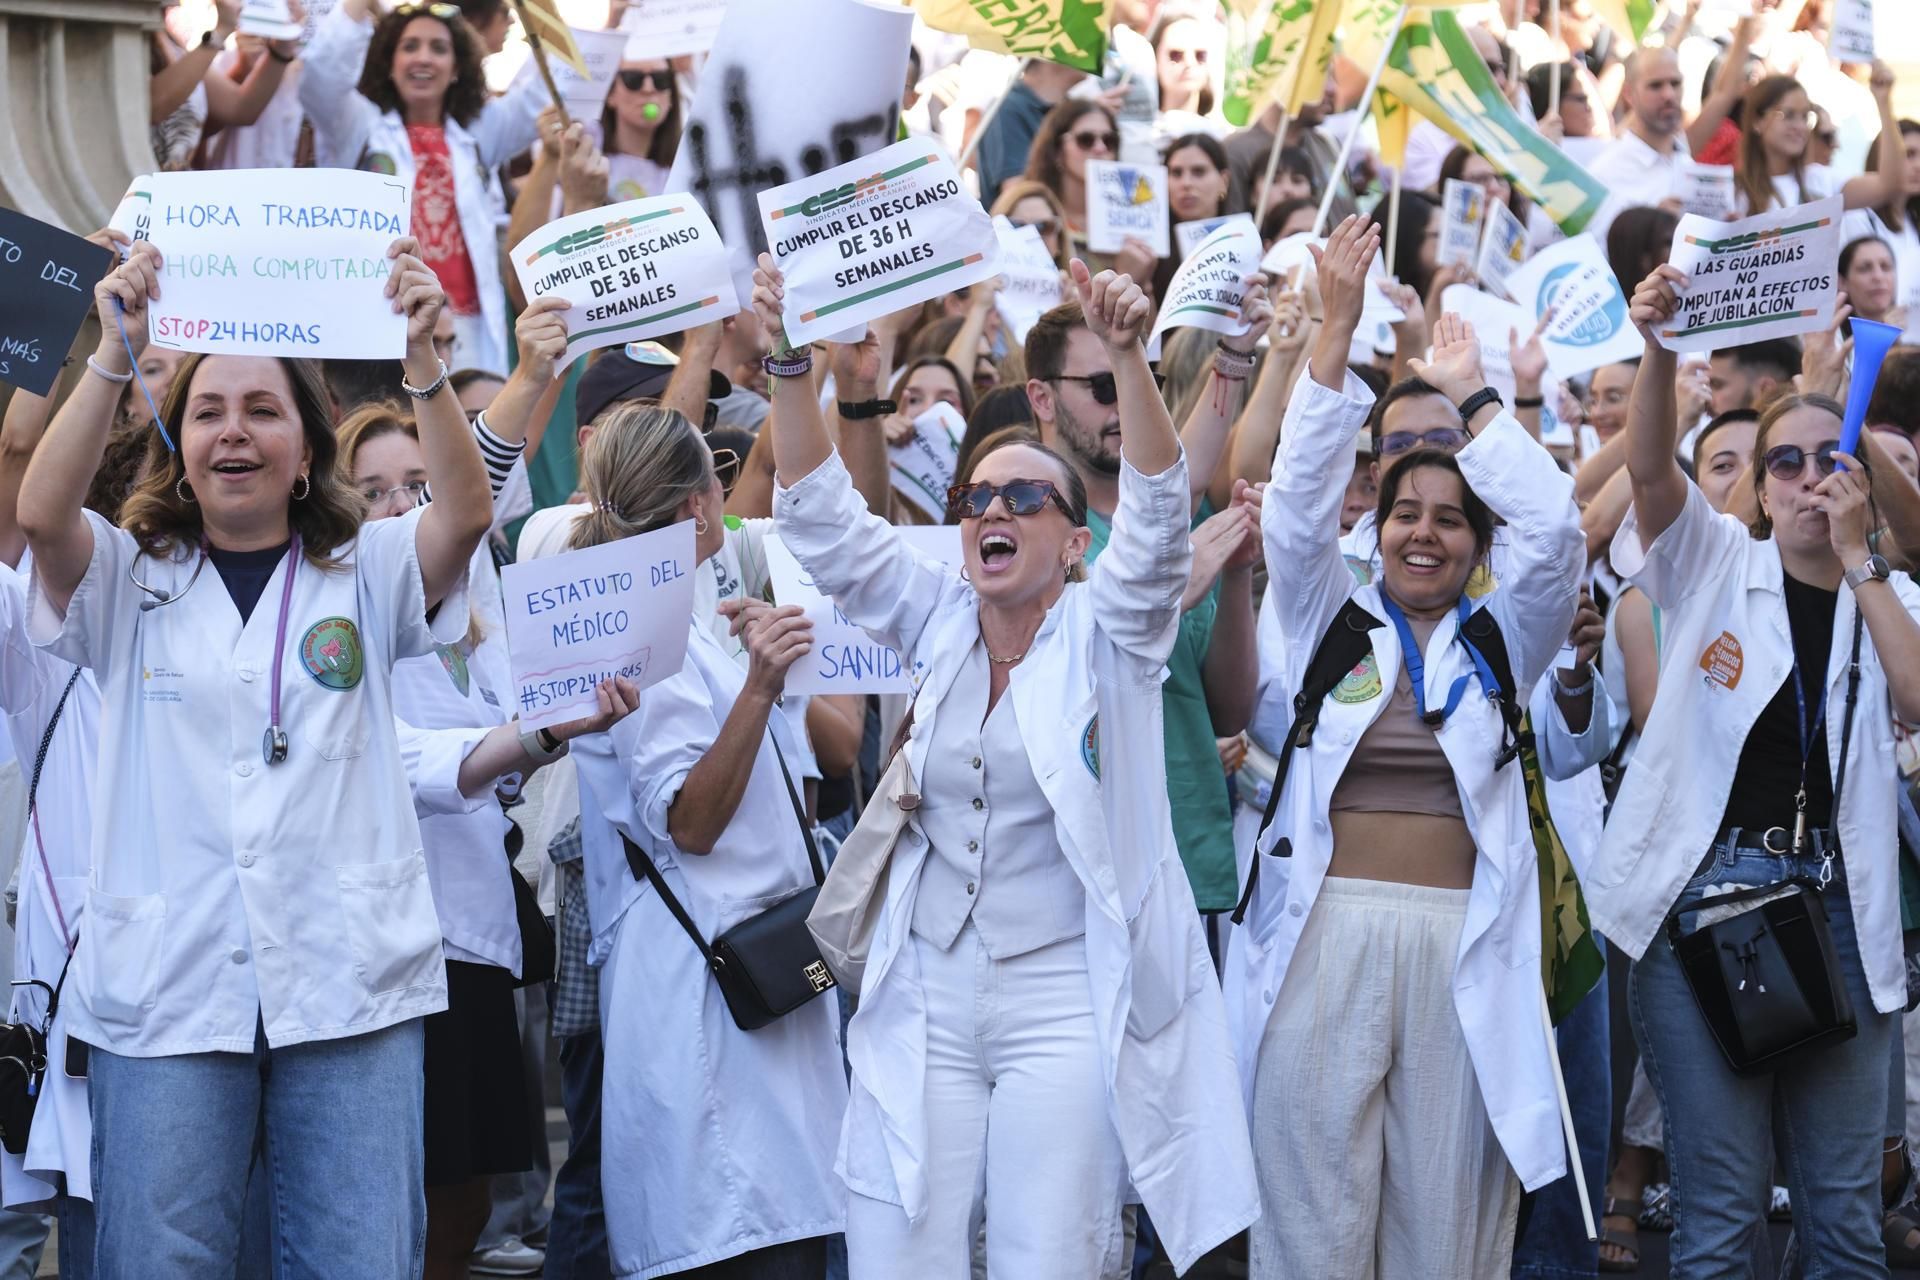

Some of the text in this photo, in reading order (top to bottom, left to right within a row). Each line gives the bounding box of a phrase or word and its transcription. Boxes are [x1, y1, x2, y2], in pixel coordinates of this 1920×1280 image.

[166, 203, 401, 235] HORA TRABAJADA
[776, 179, 959, 258] CUMPLIR EL DESCANSO
[805, 182, 917, 226] SINDICATO MÉDICO CANARIO
[558, 246, 598, 264] SINDICATO
[599, 237, 628, 250] MÉDICO
[838, 218, 913, 260] DE 36 H
[40, 259, 83, 292] DEL
[167, 254, 389, 281] HORA COMPUTADA
[534, 226, 700, 296] CUMPLIR EL DESCANSO
[590, 260, 658, 298] DE 36 H
[834, 242, 934, 288] SEMANALES
[1695, 245, 1805, 276] LAS GUARDIAS
[1736, 271, 1759, 286] NO
[586, 284, 677, 322] SEMANALES
[1198, 288, 1214, 302] DE
[1676, 275, 1830, 312] OMPUTAN A EFECTOS
[1688, 291, 1795, 329] DE JUBILACIÓN
[526, 560, 685, 615] ESTATUTO DEL
[553, 610, 629, 648] MÉDICO
